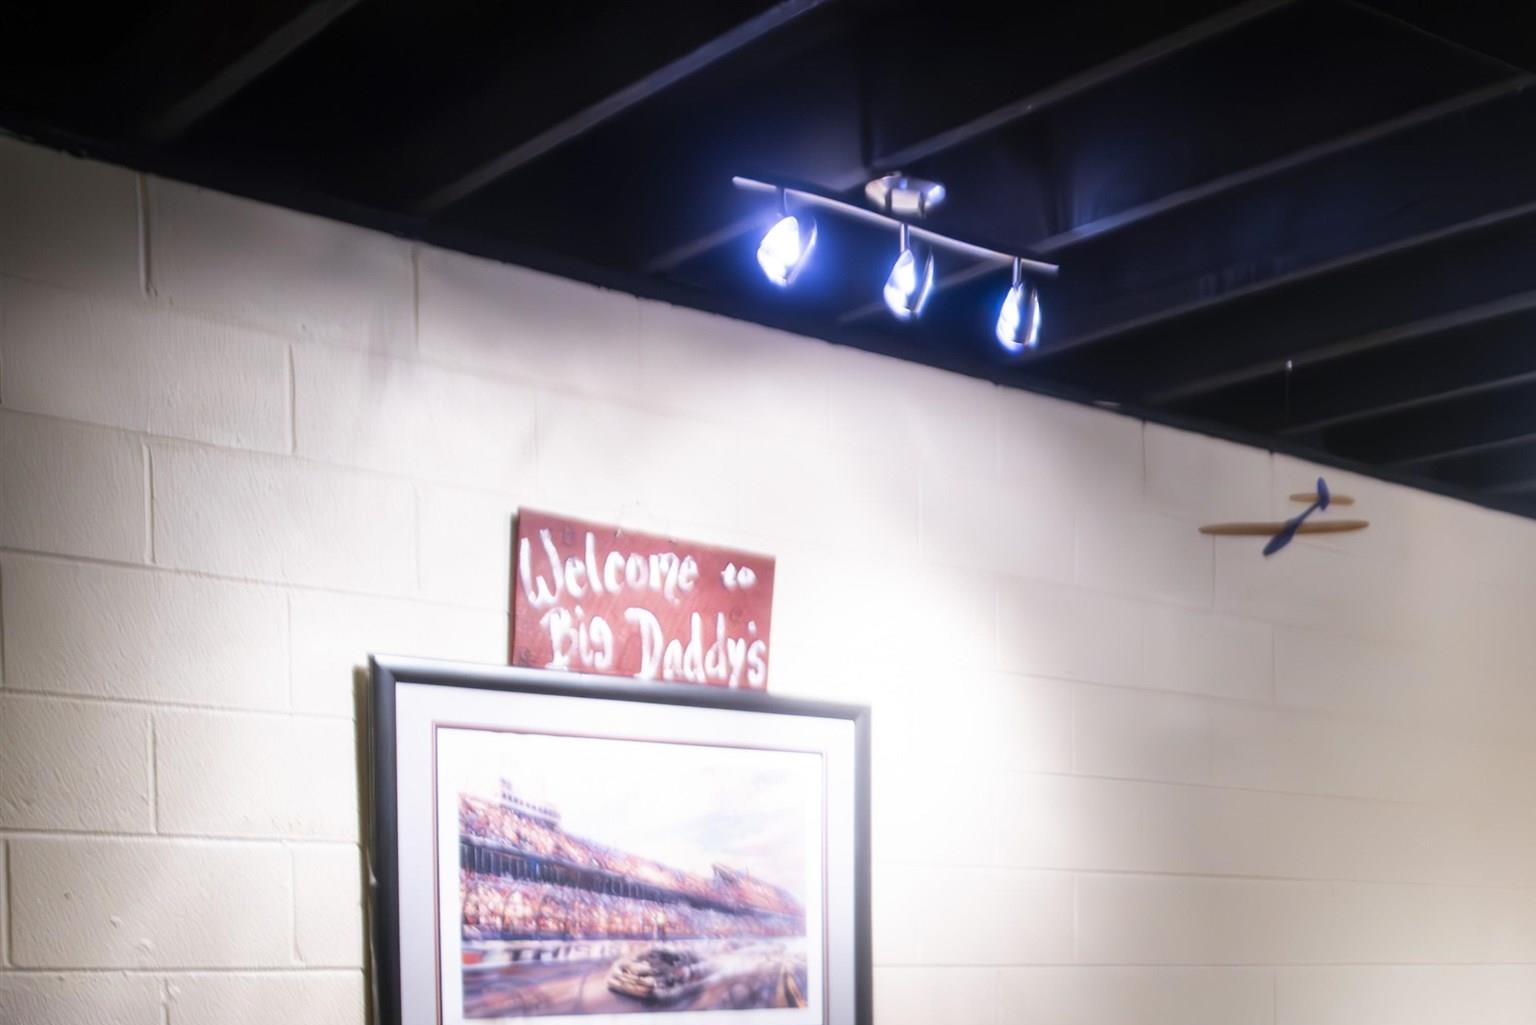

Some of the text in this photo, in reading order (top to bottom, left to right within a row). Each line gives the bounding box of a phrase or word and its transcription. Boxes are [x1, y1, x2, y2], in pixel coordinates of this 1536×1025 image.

[518, 528, 757, 608] Welcome to
[539, 604, 767, 689] Big Daddy's
